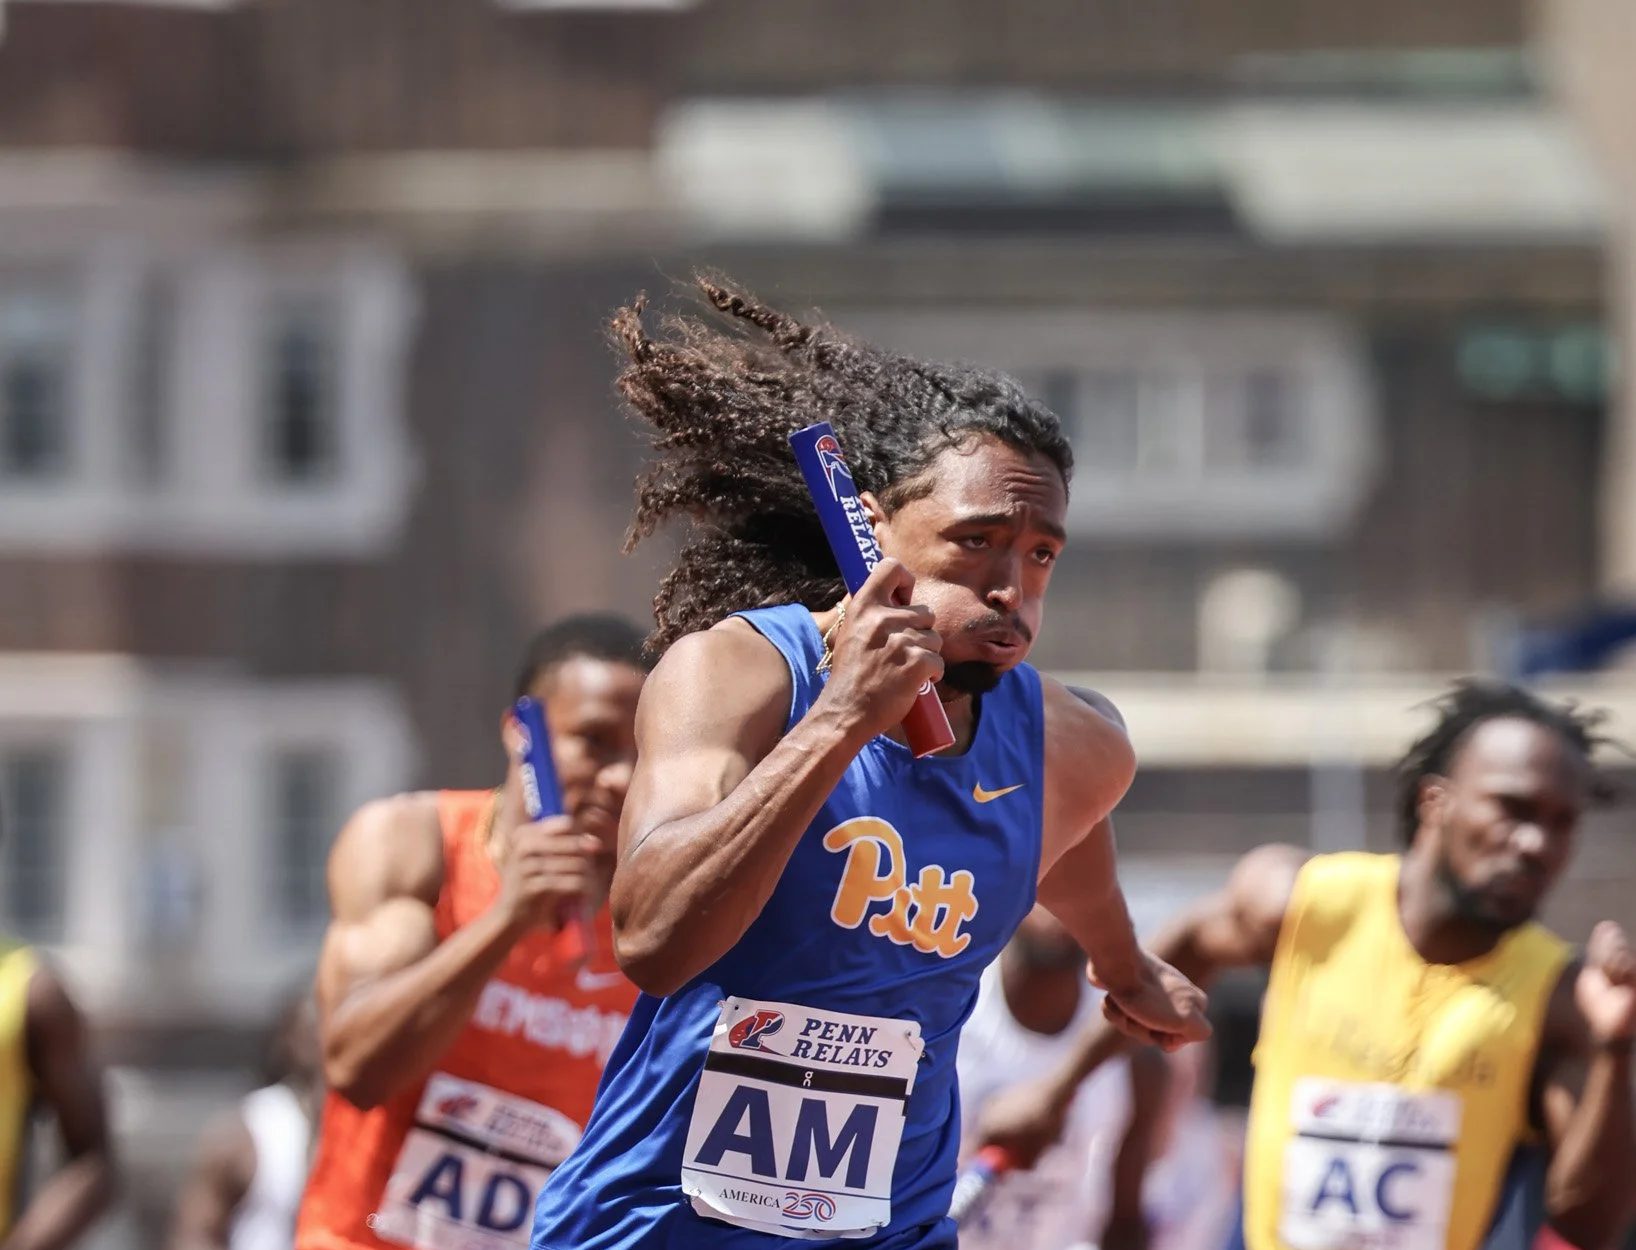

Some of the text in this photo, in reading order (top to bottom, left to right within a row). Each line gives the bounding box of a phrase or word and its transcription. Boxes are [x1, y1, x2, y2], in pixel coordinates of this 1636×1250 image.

[823, 816, 979, 959] Pitt
[790, 1039, 892, 1068] RELAYS
[800, 1019, 877, 1044] PENN
[694, 1085, 879, 1189] AM
[410, 1153, 532, 1233] AD
[719, 1188, 837, 1223] AMERICA 250
[1311, 1158, 1419, 1221] AC
